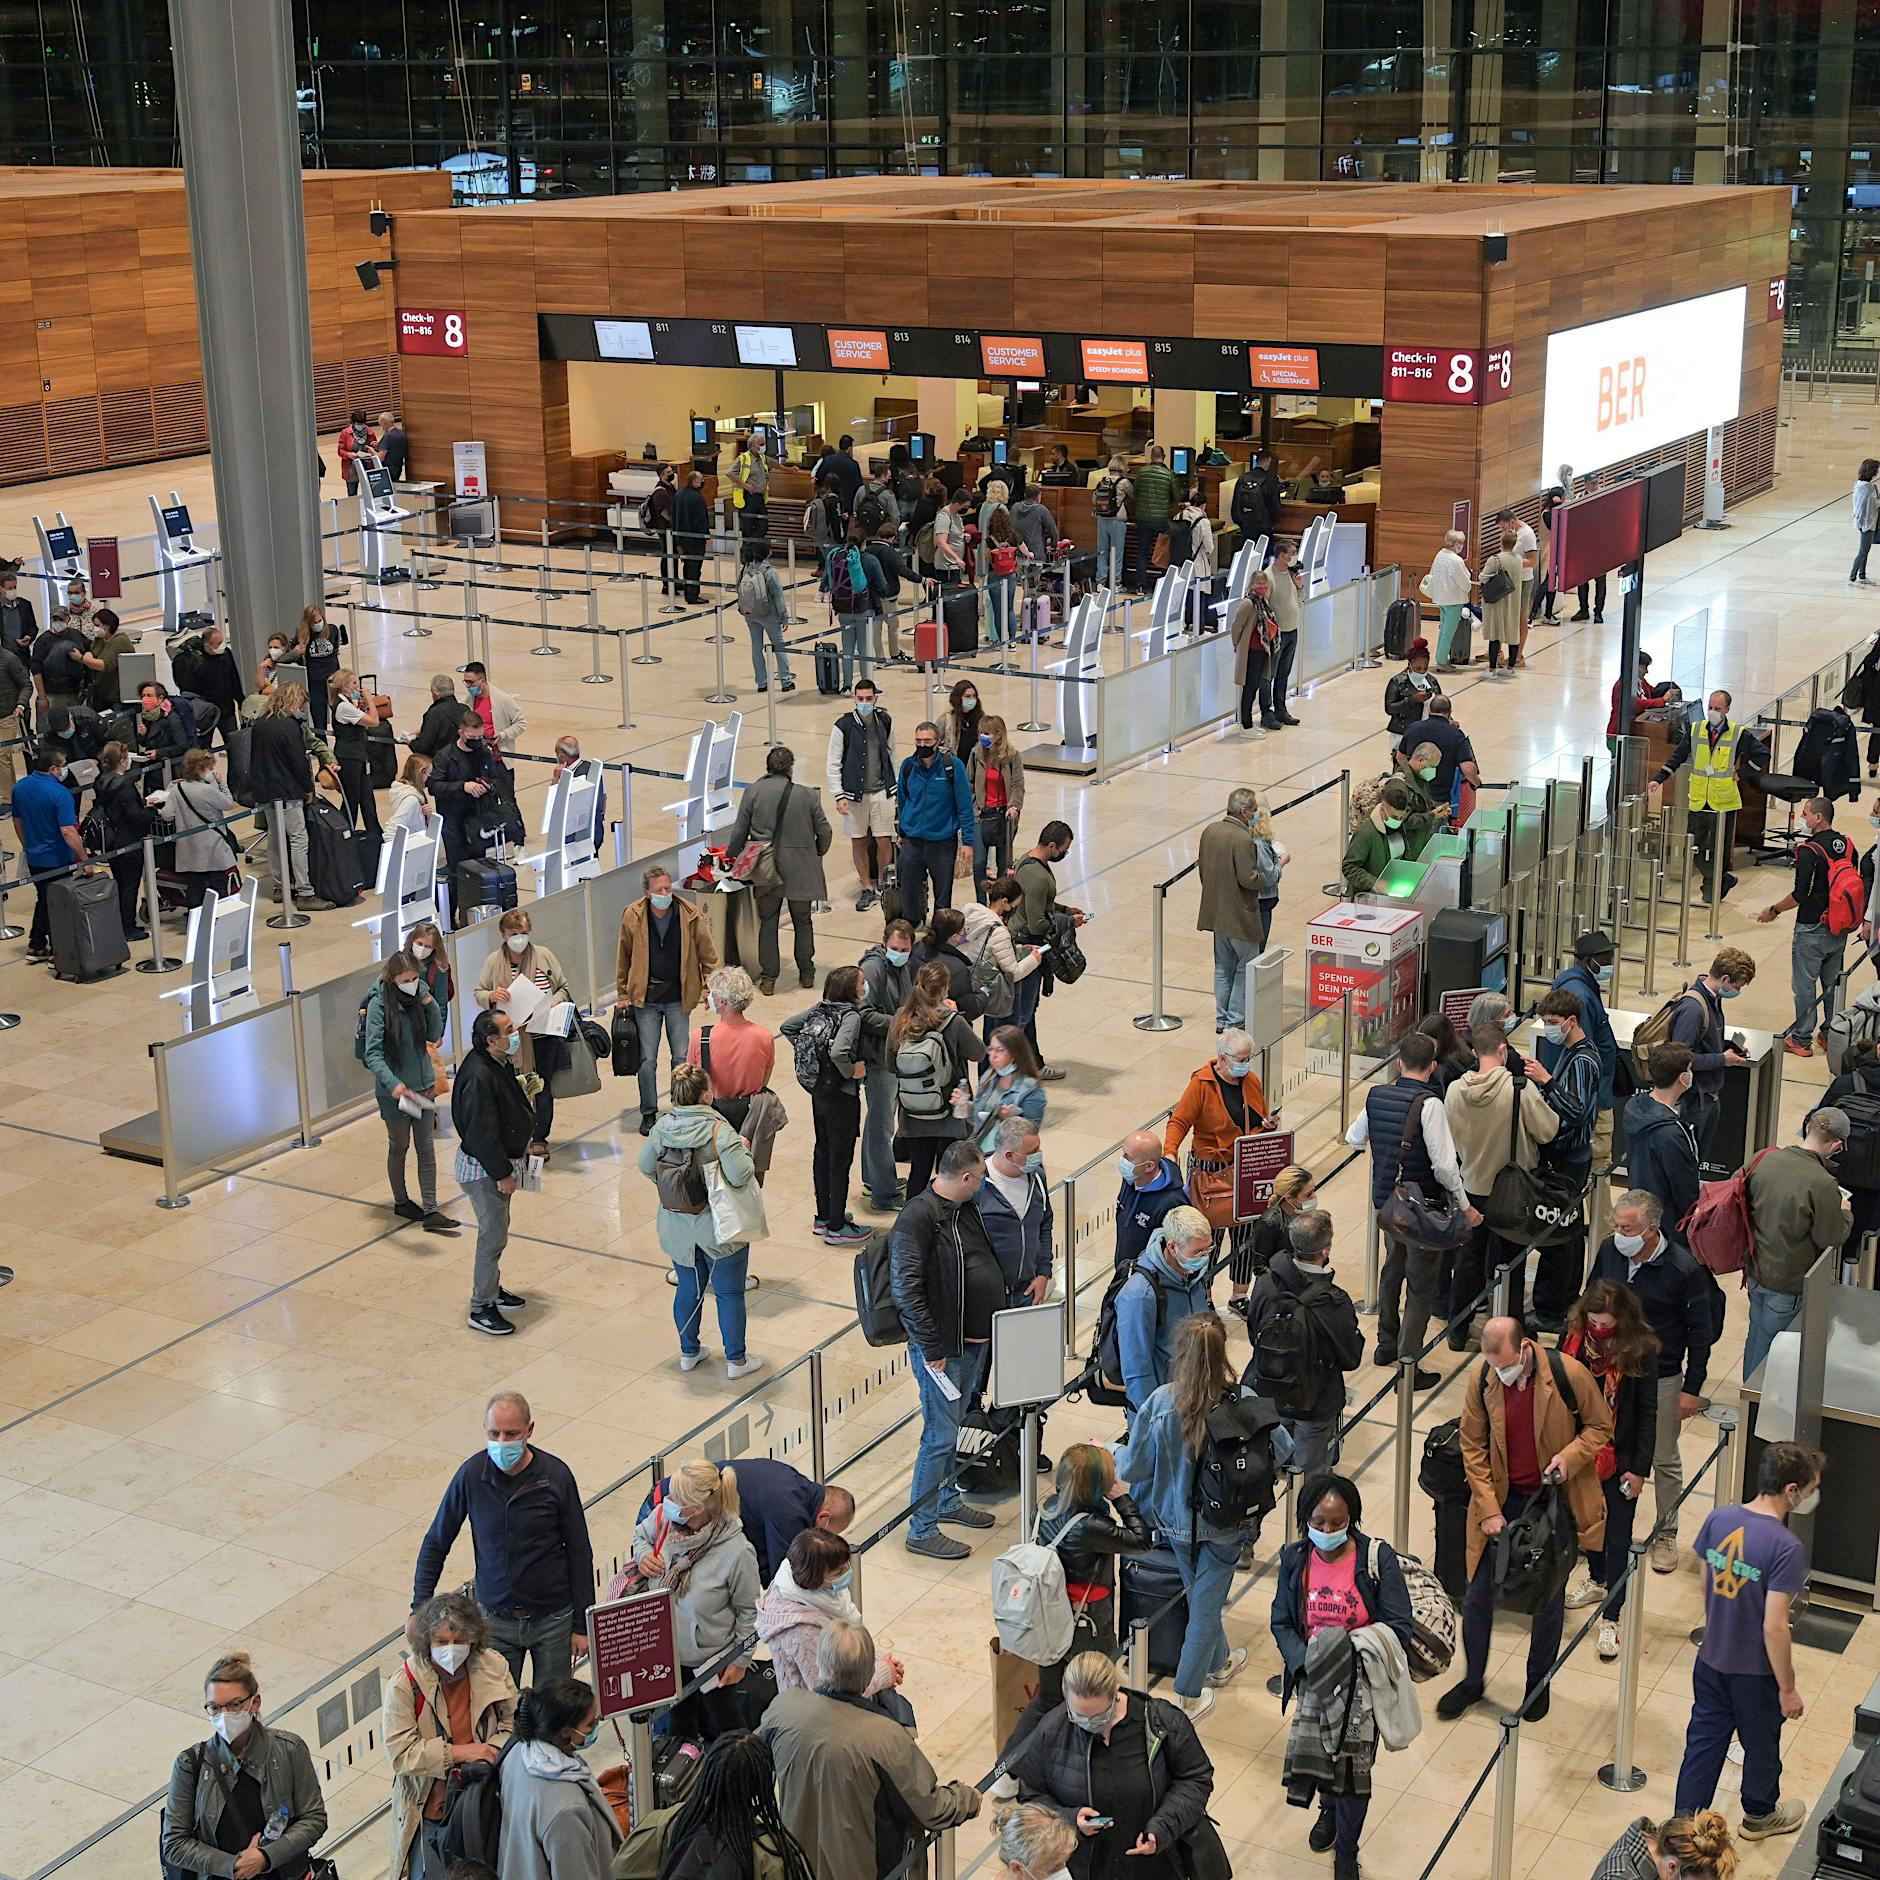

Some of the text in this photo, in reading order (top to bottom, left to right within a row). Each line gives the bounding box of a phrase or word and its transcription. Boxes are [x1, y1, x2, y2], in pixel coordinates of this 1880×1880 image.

[1777, 280, 1784, 310] 8
[402, 313, 464, 348] Check-in 8
[655, 323, 670, 332] 811
[711, 324, 727, 334] 812
[894, 332, 971, 344] 813 814
[834, 340, 882, 350] CUSTOMER
[1155, 343, 1239, 355] 815 816
[835, 349, 872, 359] SERVICE
[987, 347, 1038, 358] CUSTOMER
[1087, 346, 1142, 357] easyJet plus
[1258, 353, 1292, 362] easyJet
[988, 357, 1026, 366] SERVICE
[1088, 366, 1143, 375] SPEEDY BOARDING
[1271, 370, 1298, 378] SPECIAL
[1391, 352, 1474, 394] Check-in 8
[1500, 350, 1511, 389] 8
[1272, 377, 1310, 385] ASSISTANCE
[1597, 356, 1646, 432] BER
[1311, 934, 1333, 947] BER
[1318, 972, 1355, 984] SPENDE
[1318, 983, 1340, 994] DEIN
[598, 1612, 619, 1621] Weniger
[643, 1601, 660, 1609] Leeren
[1318, 1602, 1347, 1615] COOPER
[618, 1610, 653, 1622] Hosentaschen
[608, 1629, 632, 1638] Kontrolle
[649, 1628, 660, 1636] your
[743, 1634, 756, 1649] BER
[994, 1761, 1007, 1779] BER
